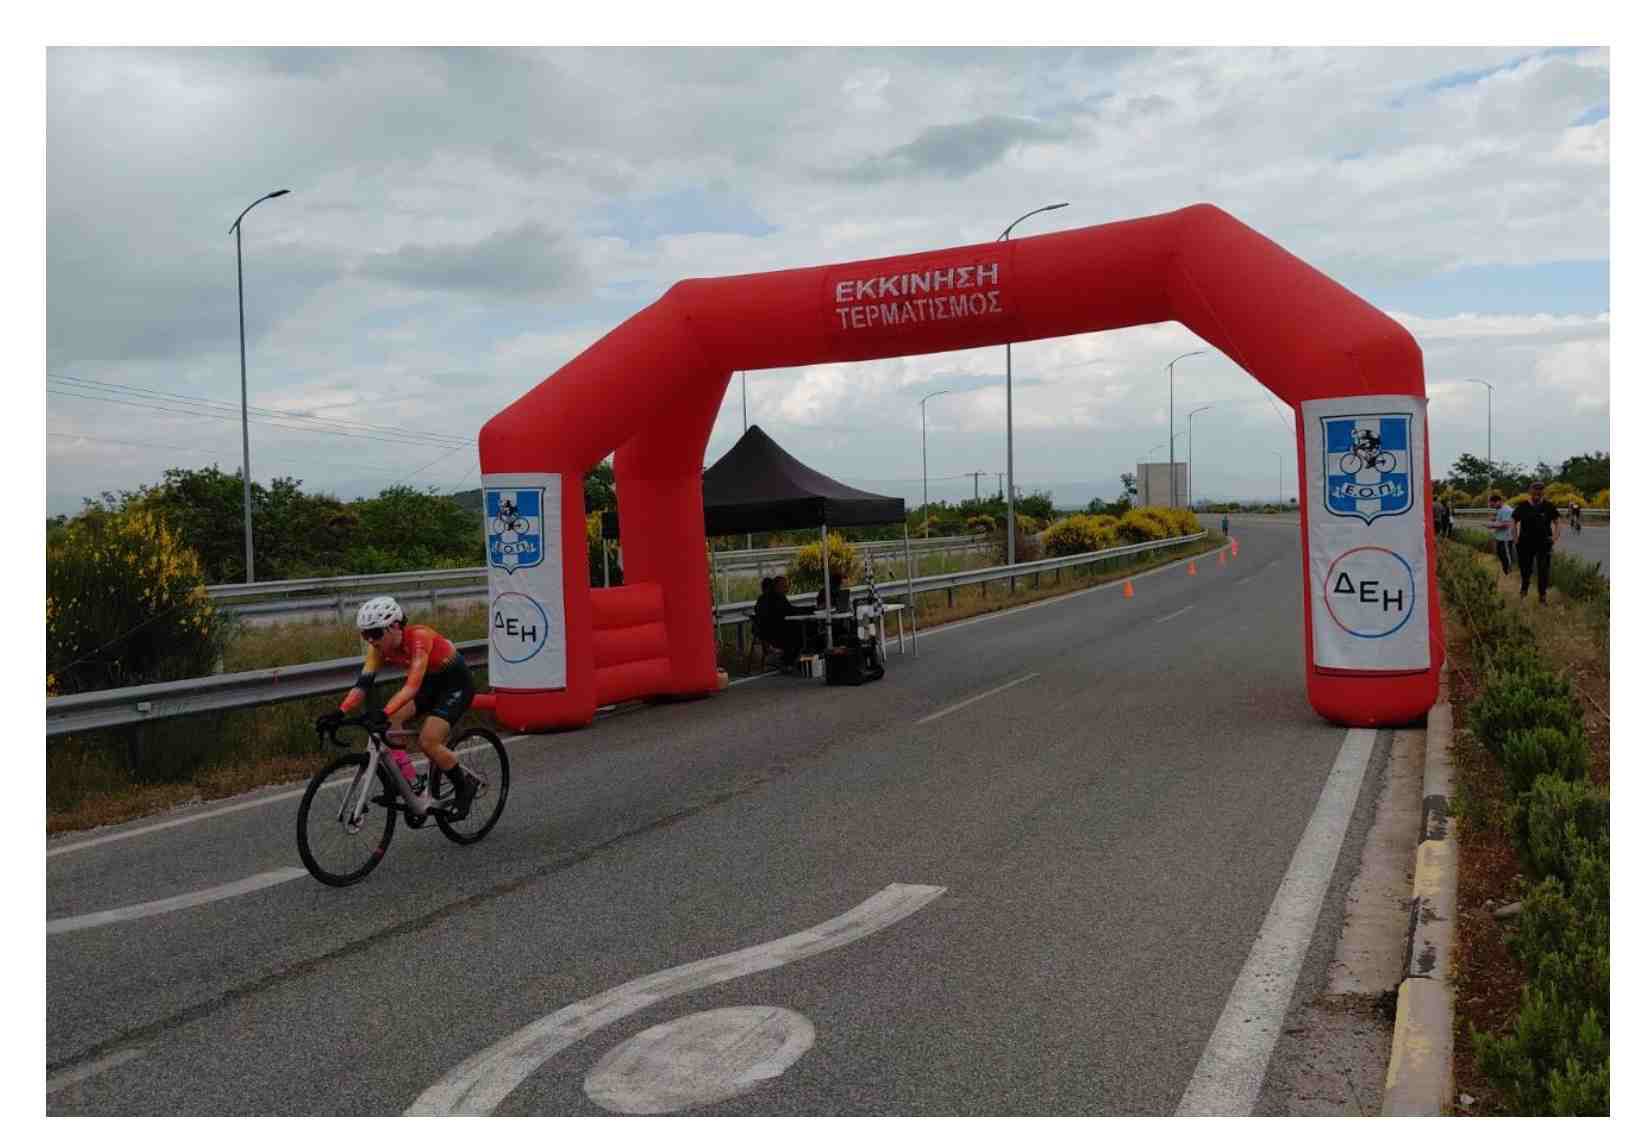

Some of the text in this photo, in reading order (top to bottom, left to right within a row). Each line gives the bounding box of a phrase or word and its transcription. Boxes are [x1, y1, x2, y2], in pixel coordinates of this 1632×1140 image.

[835, 263, 999, 302] ΕΚΚΙΝΗΣΗ
[835, 290, 1003, 329] ΤΕΡΜΑΤΙΣΜΟΣ
[1333, 572, 1403, 611] ΔΕΗ
[494, 611, 537, 642] ΔΕΗ
